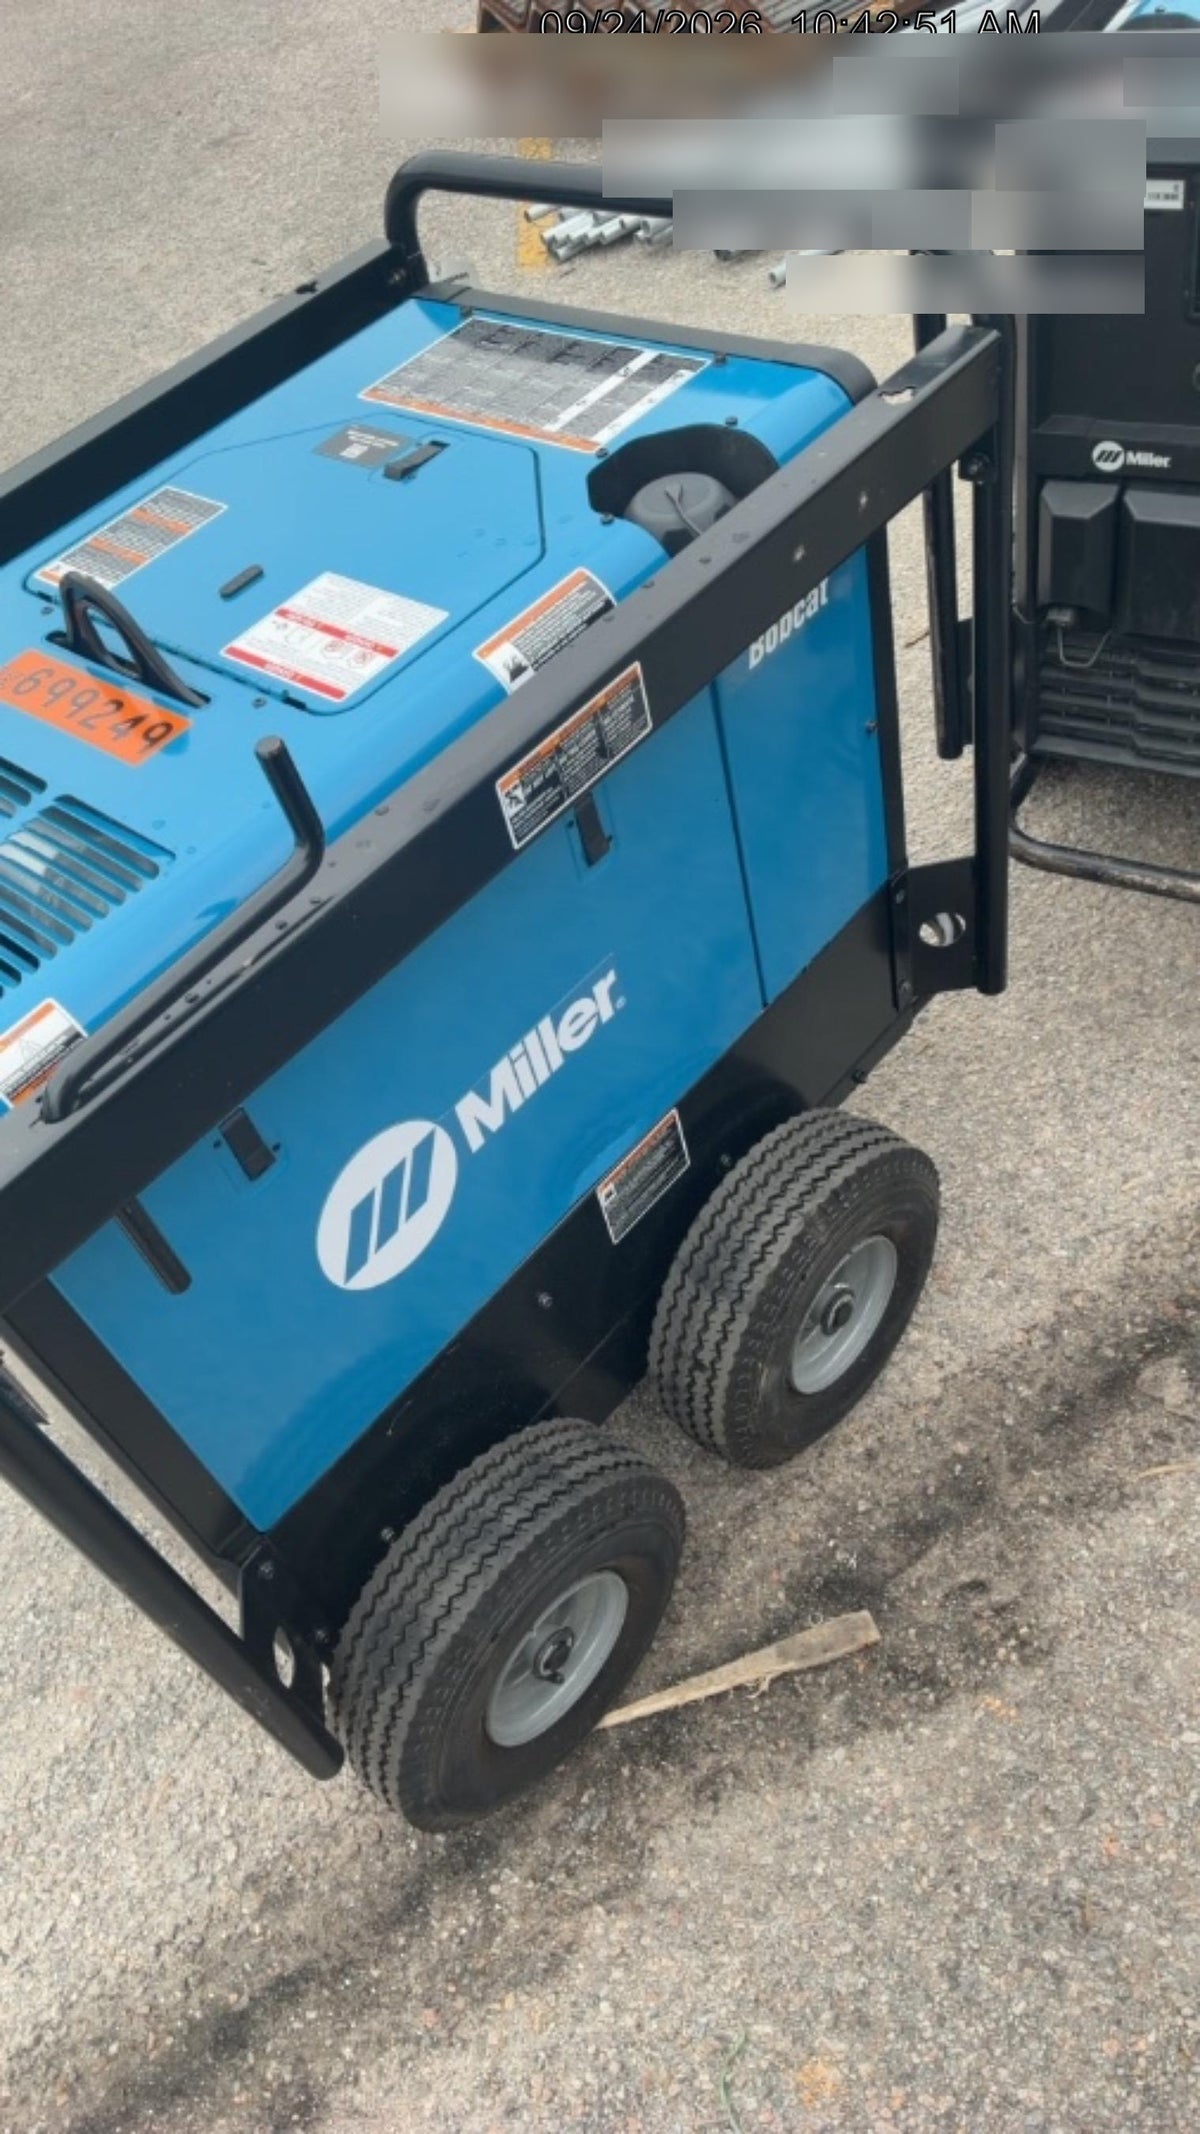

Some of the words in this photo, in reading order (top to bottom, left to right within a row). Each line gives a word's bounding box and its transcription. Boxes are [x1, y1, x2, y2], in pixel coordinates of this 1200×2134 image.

[1125, 451, 1171, 468] Miller
[13, 668, 173, 753] 699249
[455, 968, 617, 1154] Miller
